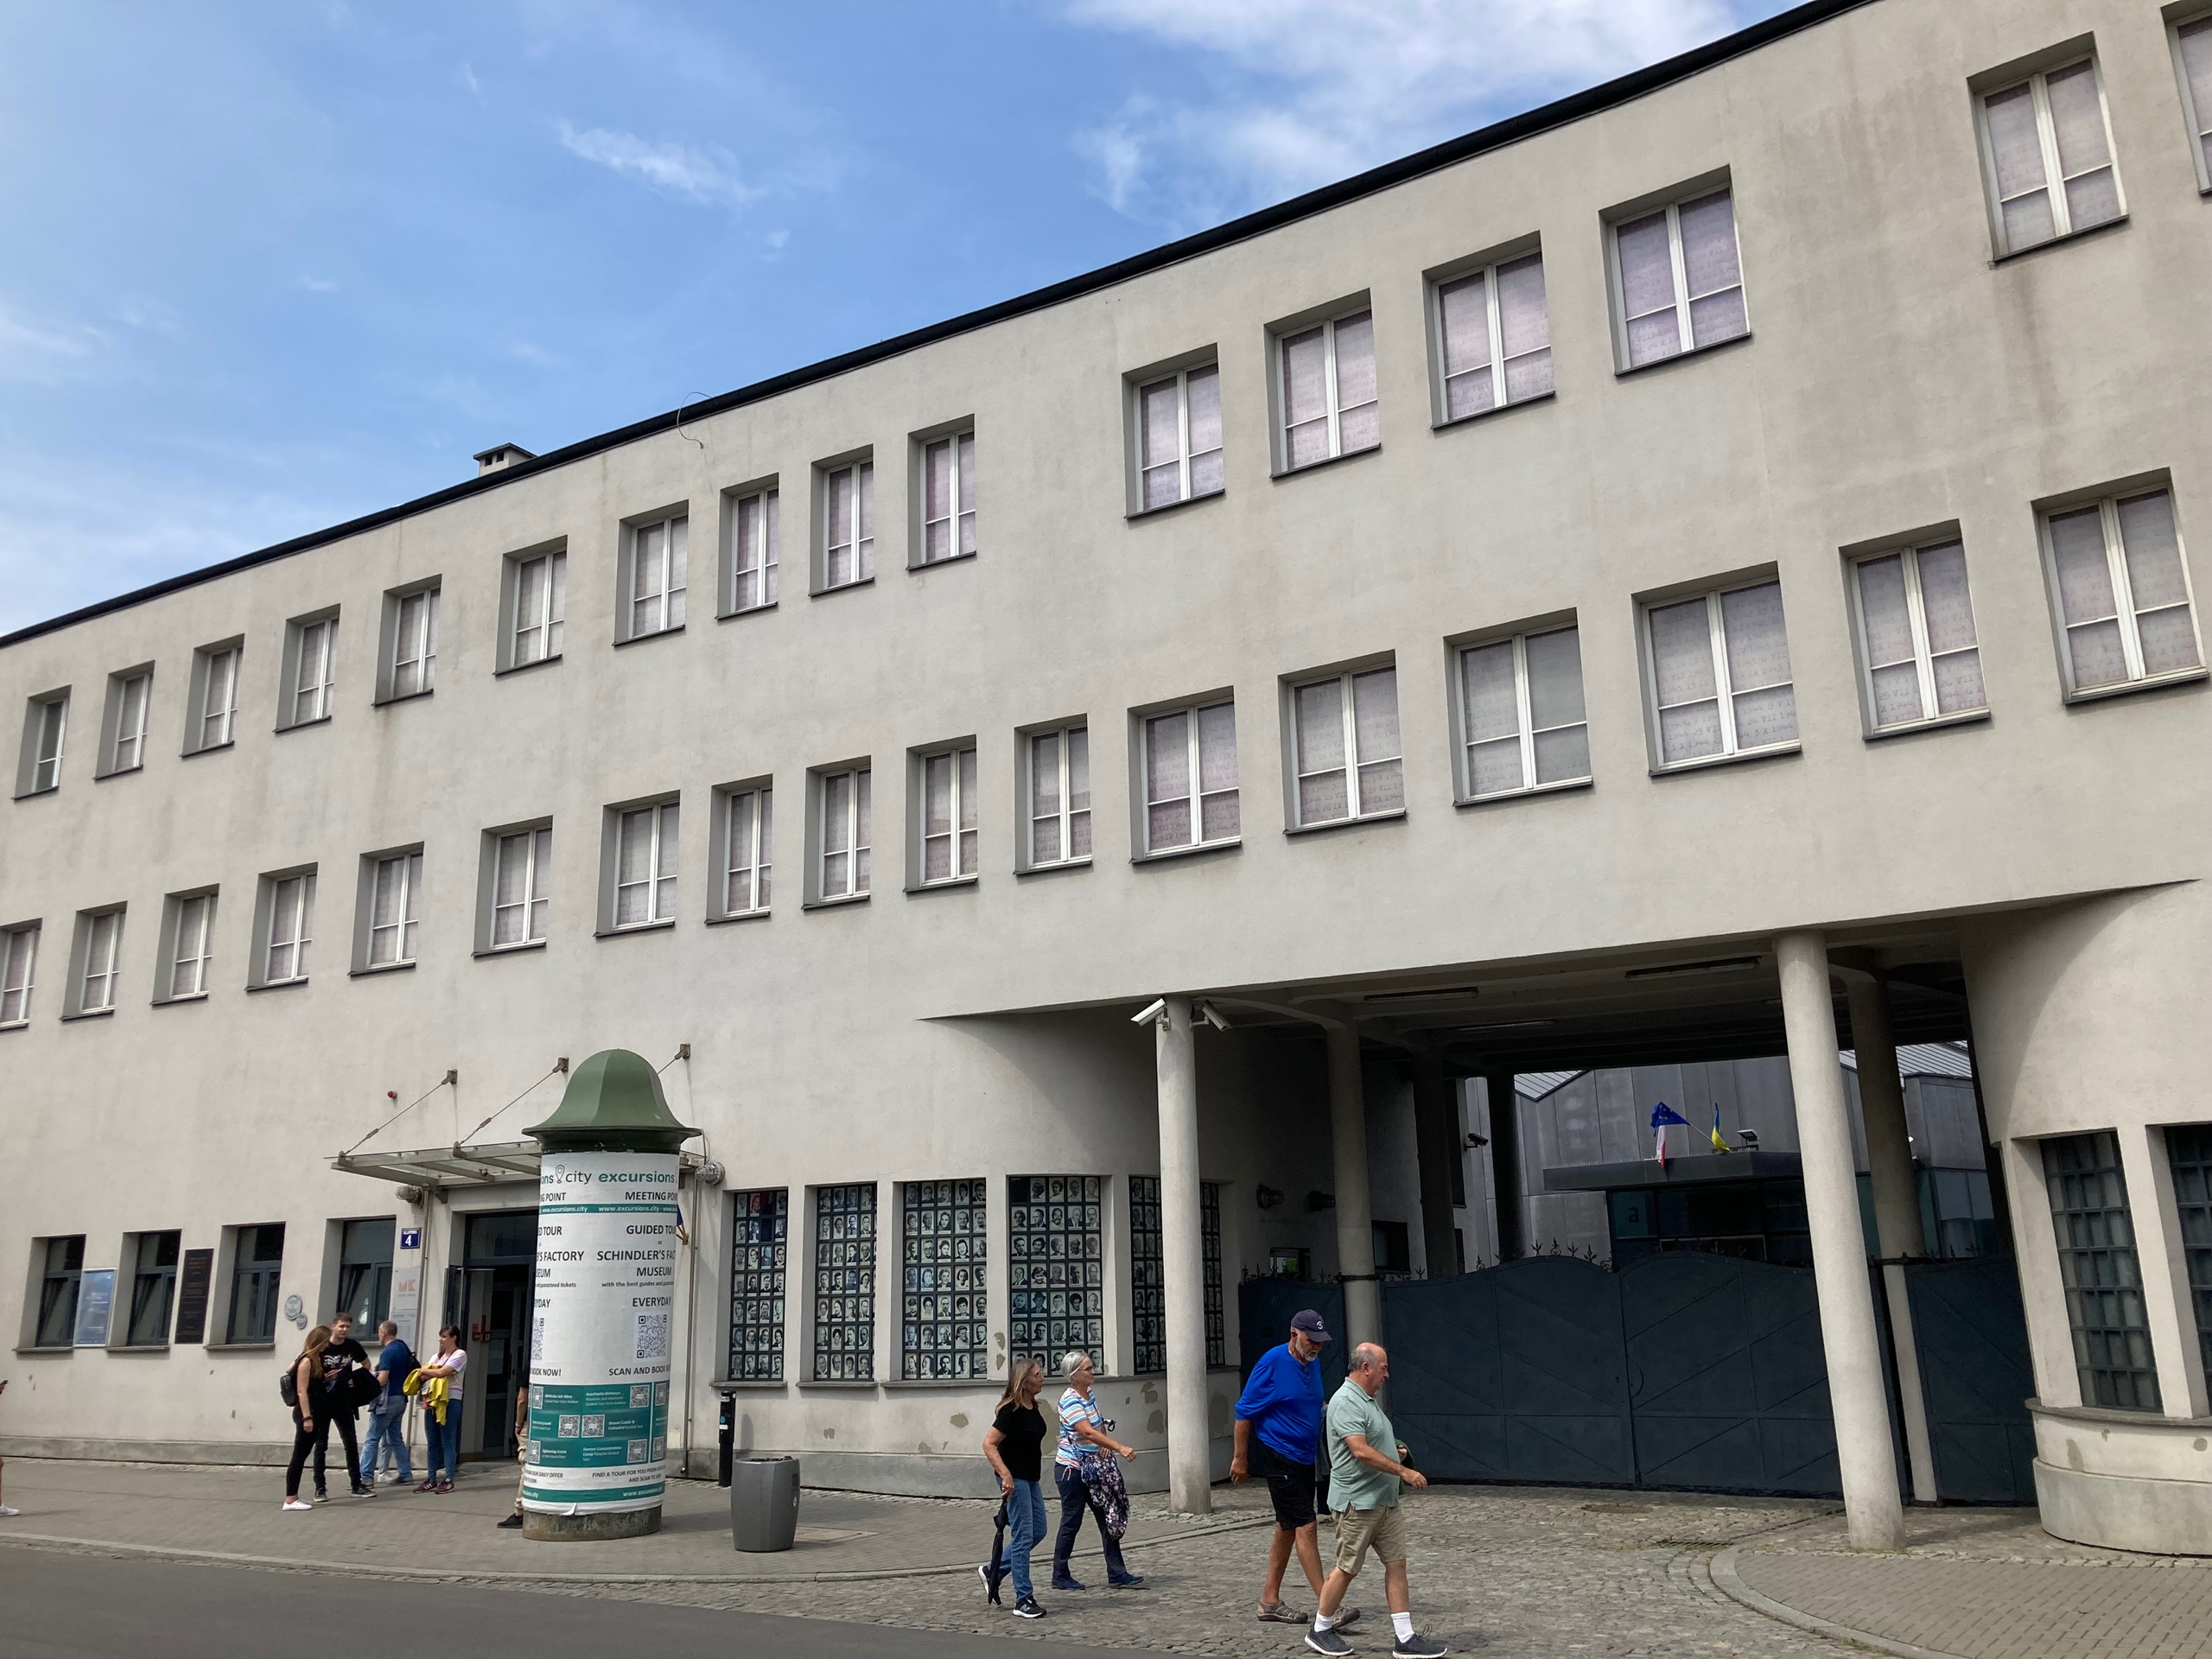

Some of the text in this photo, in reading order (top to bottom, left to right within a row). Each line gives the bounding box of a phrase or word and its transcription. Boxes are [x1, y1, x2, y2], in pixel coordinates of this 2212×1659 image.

[565, 1170, 675, 1185] city excursions
[546, 1192, 566, 1202] POINT
[625, 1192, 666, 1201] MEETING
[598, 1205, 660, 1213] www.excursions.city
[1628, 1206, 1639, 1224] a
[543, 1226, 563, 1236] TOUR
[626, 1225, 664, 1235] GUIDED
[404, 1235, 412, 1246] 4
[543, 1250, 585, 1262] FACTORY
[636, 1267, 672, 1277] MUSEUM
[632, 1297, 671, 1307] EVERYDAY
[543, 1368, 562, 1376] NOW!
[608, 1365, 665, 1376] SCAN AND BOOK
